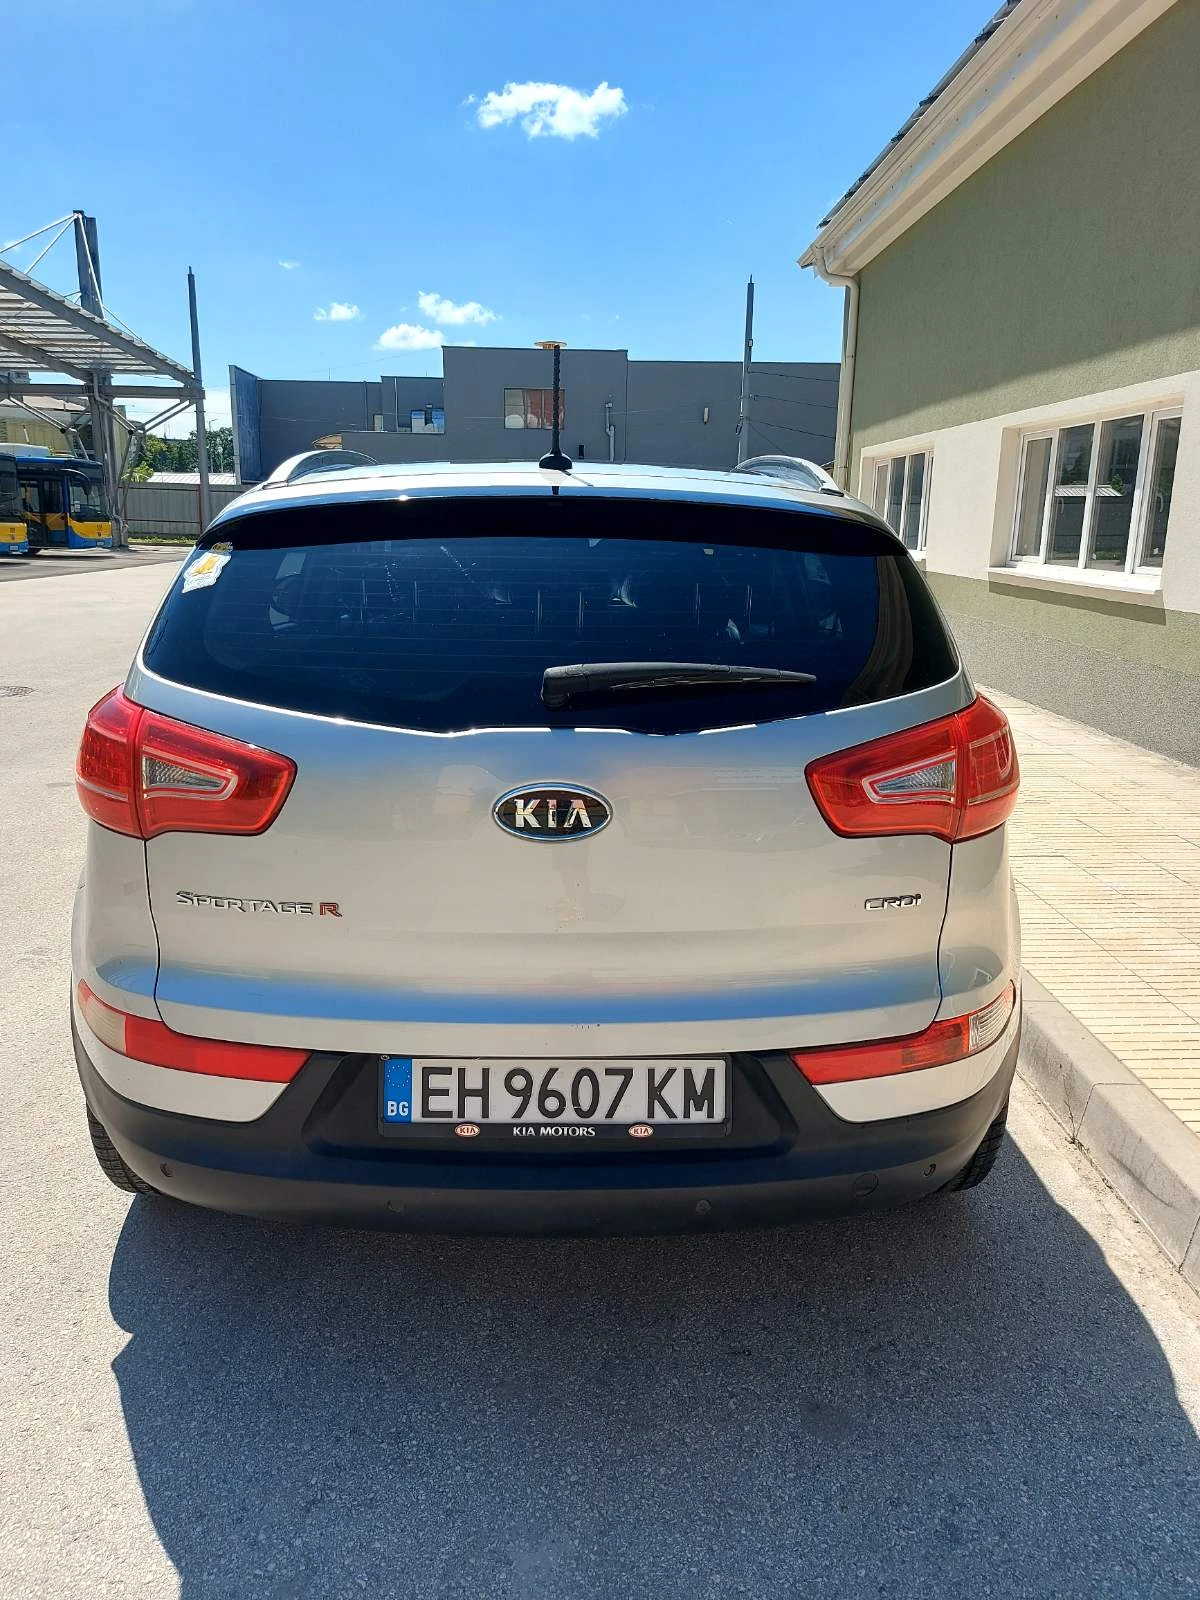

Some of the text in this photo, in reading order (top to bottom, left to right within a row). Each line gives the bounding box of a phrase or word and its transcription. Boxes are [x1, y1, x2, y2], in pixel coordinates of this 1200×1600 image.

[514, 799, 592, 828] KIA
[176, 890, 343, 918] SPORTAGE R
[421, 1066, 716, 1119] EH 9607 KM
[387, 1100, 409, 1116] BG
[457, 1126, 477, 1136] KIA
[513, 1126, 596, 1137] KIA MOTORS
[631, 1126, 651, 1136] KIA
